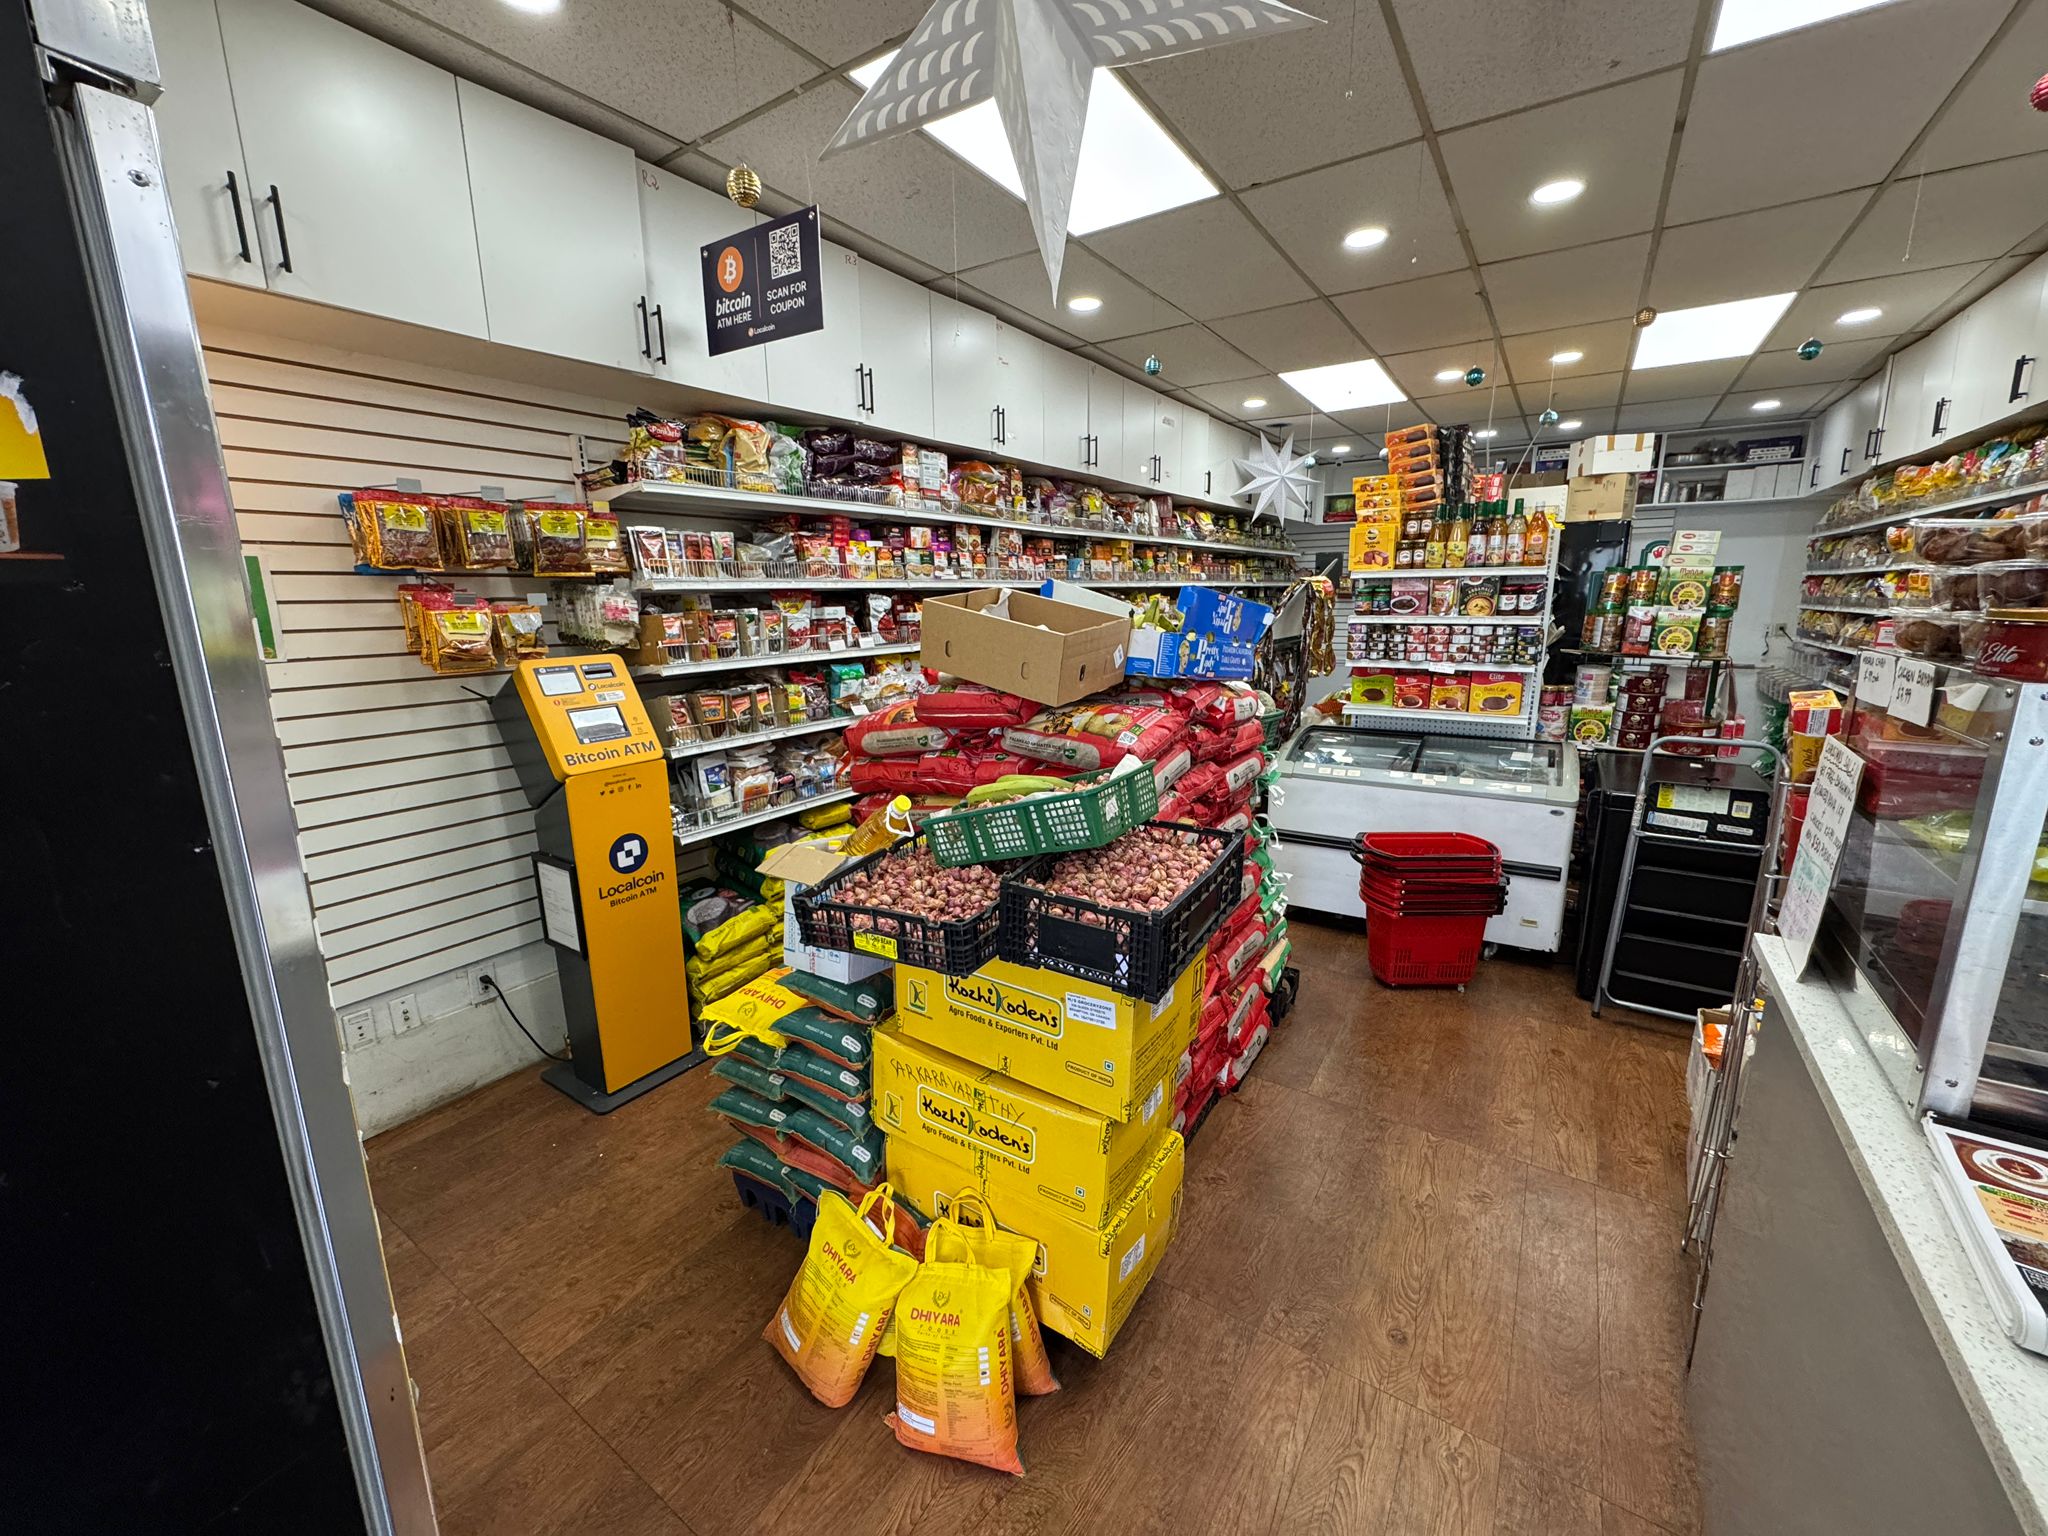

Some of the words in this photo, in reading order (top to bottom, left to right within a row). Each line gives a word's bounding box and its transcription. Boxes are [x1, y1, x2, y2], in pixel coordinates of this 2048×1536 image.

[767, 288, 789, 301] SCAN
[790, 281, 807, 296] FOR
[716, 292, 751, 316] bitcoin
[770, 297, 805, 314] COUPON
[717, 315, 733, 329] ATM
[733, 311, 752, 325] HERE
[754, 324, 775, 335] Localcoin
[1196, 639, 1220, 660] Pretty
[1981, 642, 2025, 664] Elite
[1194, 656, 1215, 675] Lady
[597, 681, 625, 690] Localcoin
[564, 748, 620, 767] Bitcoin
[624, 741, 656, 755] ATM
[599, 872, 664, 900] Localcoin
[610, 894, 638, 907] Bitcoin
[640, 887, 657, 898] ATM
[739, 987, 786, 1009] DHIYARA
[948, 1005, 972, 1021] Agro
[972, 1013, 986, 1026] Foods
[988, 1018, 994, 1028] &
[995, 1020, 1029, 1041] Exporters
[1030, 1033, 1044, 1046] Pvt.
[1046, 1040, 1059, 1051] Ltd
[1067, 1064, 1090, 1076] PRODUCT
[1098, 1075, 1112, 1085] INDIA
[922, 1122, 937, 1135] Agro
[939, 1130, 958, 1145] Foods
[1002, 1155, 1016, 1169] Pvt.
[1018, 1163, 1030, 1174] Ltd
[1039, 1187, 1062, 1200] PRODUCT
[1070, 1198, 1083, 1209] INDIA
[822, 1241, 857, 1284] DHIYARA
[911, 1308, 960, 1326] DHIYARA
[862, 1308, 891, 1361] DHIYARA
[996, 1328, 1010, 1396] DHIYARA
